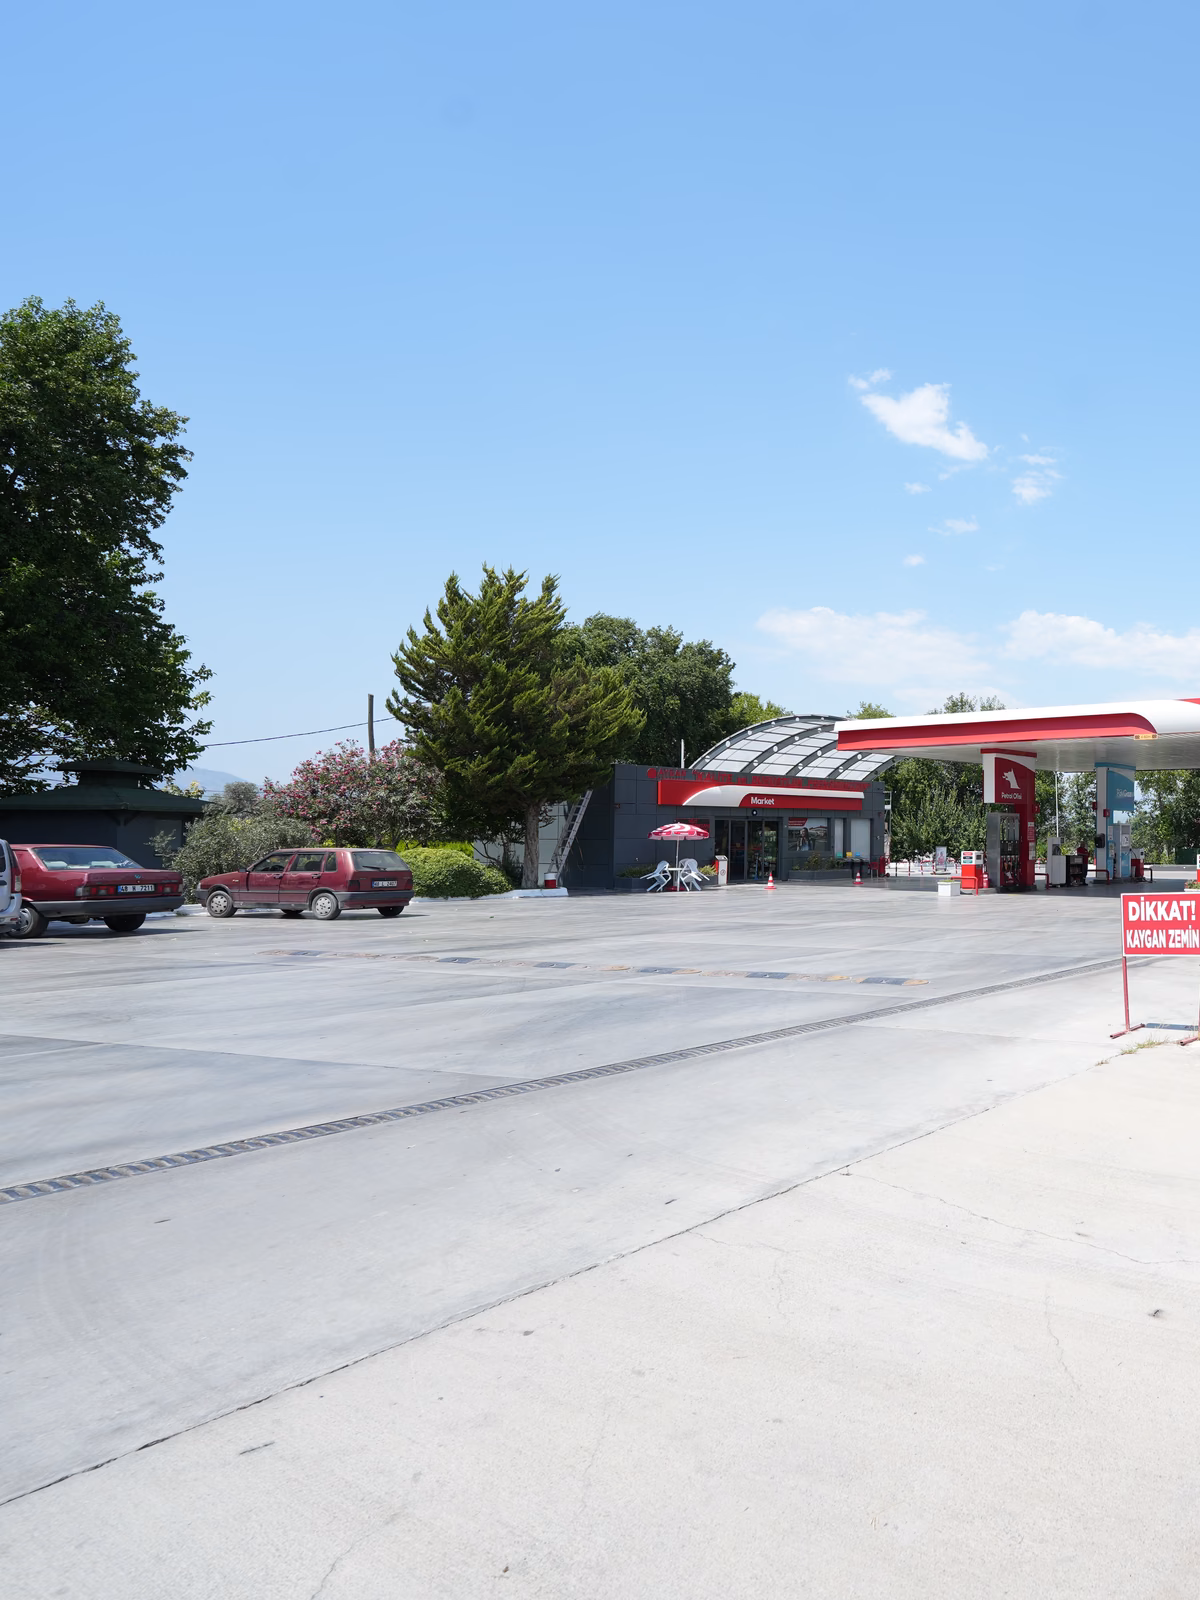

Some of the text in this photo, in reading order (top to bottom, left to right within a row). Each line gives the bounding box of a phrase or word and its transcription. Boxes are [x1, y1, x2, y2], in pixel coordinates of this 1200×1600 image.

[750, 796, 775, 805] Market
[1001, 791, 1013, 800] Petrol
[1127, 896, 1197, 922] DİKKAT!
[1125, 924, 1200, 949] KAYGAN ZEMİN
